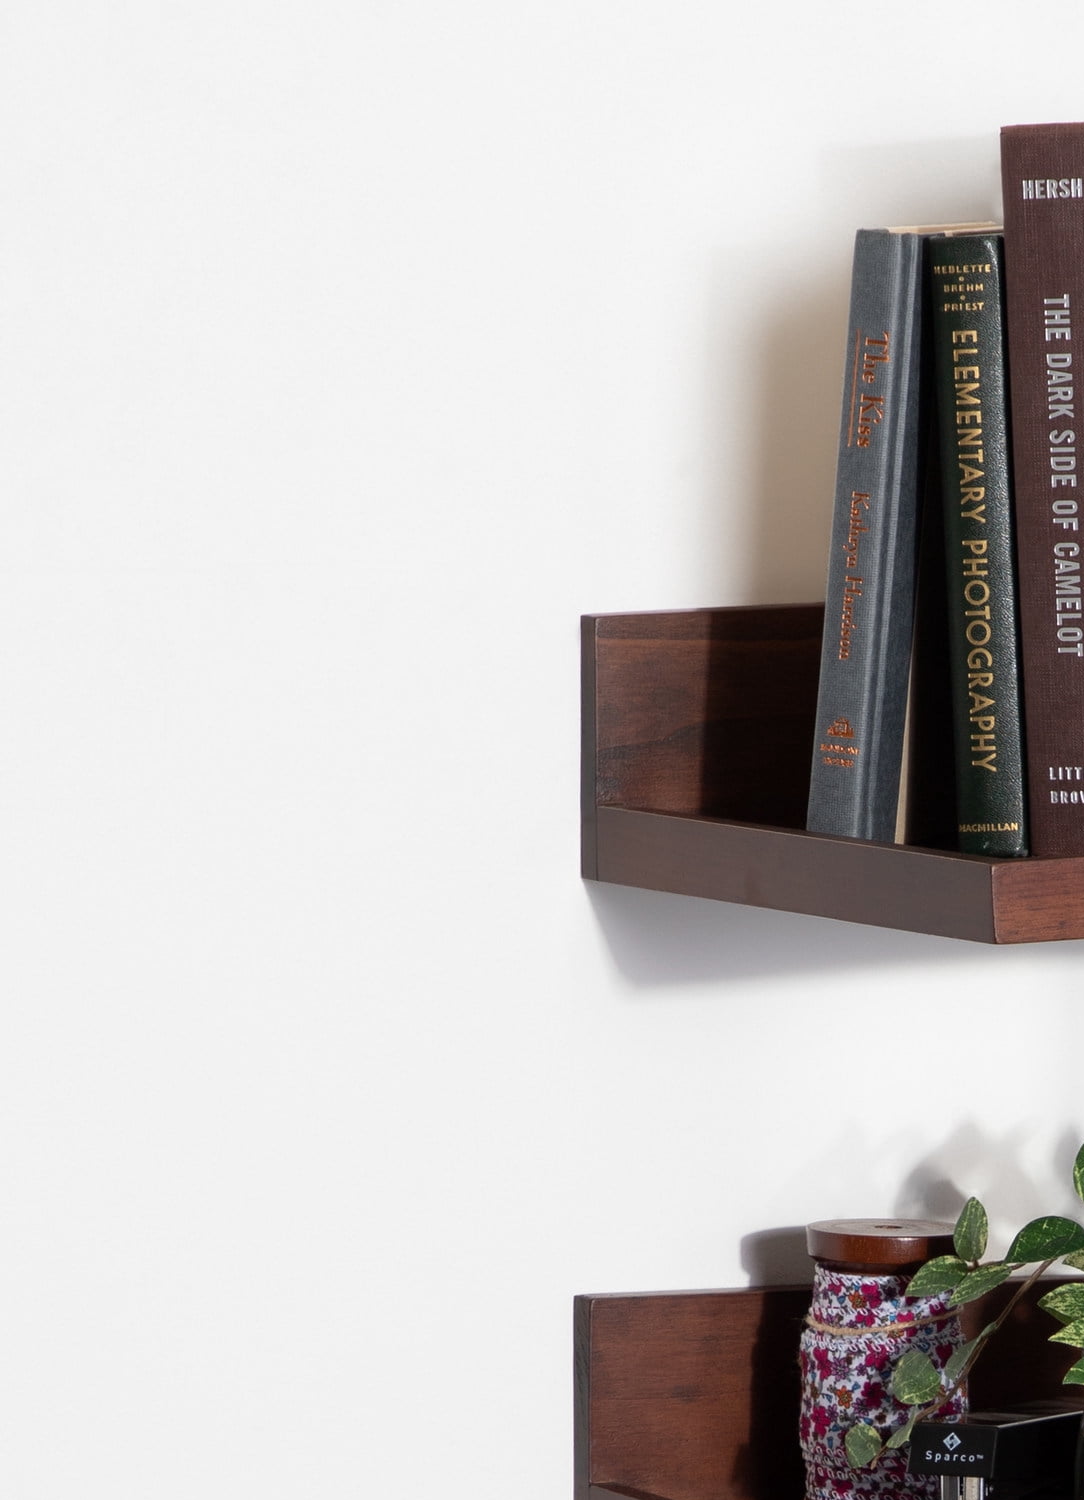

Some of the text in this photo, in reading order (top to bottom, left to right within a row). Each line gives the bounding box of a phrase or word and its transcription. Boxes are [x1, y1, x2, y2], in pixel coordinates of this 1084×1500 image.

[1022, 178, 1083, 200] HERSH
[943, 283, 984, 293] BREHM
[943, 302, 985, 312] PRIEST
[856, 331, 891, 449] The Kiss
[1044, 293, 1084, 657] THE DARK SIDE OF CAMELOT
[838, 490, 871, 661] Kathryn Harrison
[951, 330, 998, 773] ELEMENTARY PHOTOGRAPHY
[959, 821, 1019, 833] MACMILLAN
